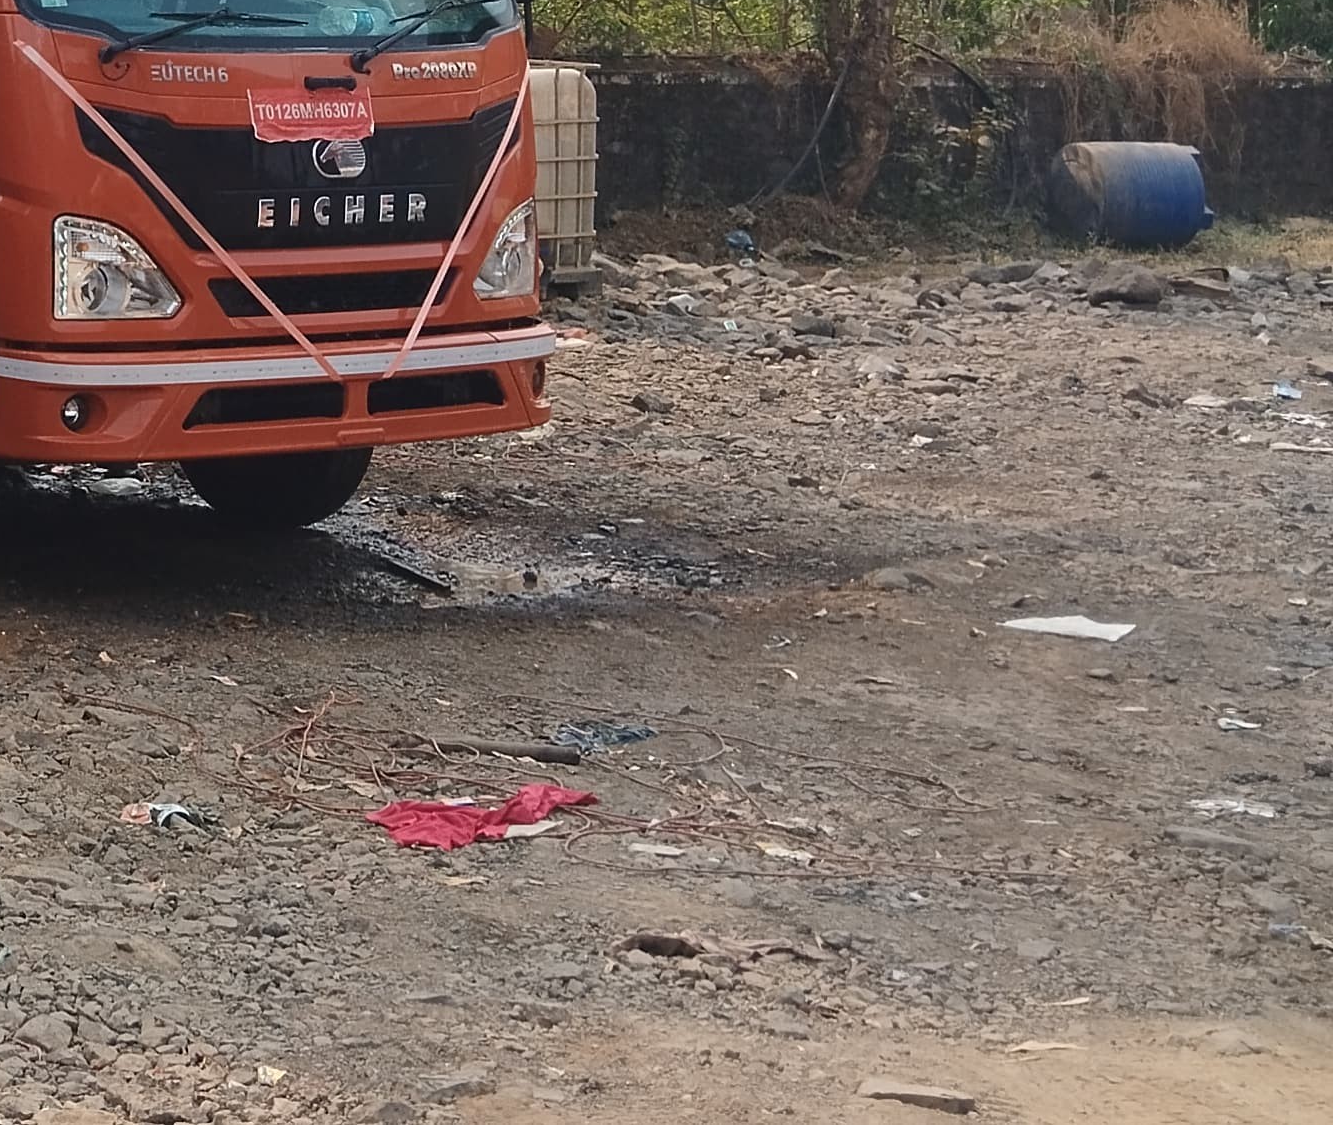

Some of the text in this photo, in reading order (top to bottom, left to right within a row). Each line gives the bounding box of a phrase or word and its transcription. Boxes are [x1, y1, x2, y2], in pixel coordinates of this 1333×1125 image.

[218, 66, 229, 82] 6
[391, 61, 478, 80] Pro 2080XP
[254, 101, 369, 121] T0126MH6307A
[257, 193, 427, 227] EICHER
